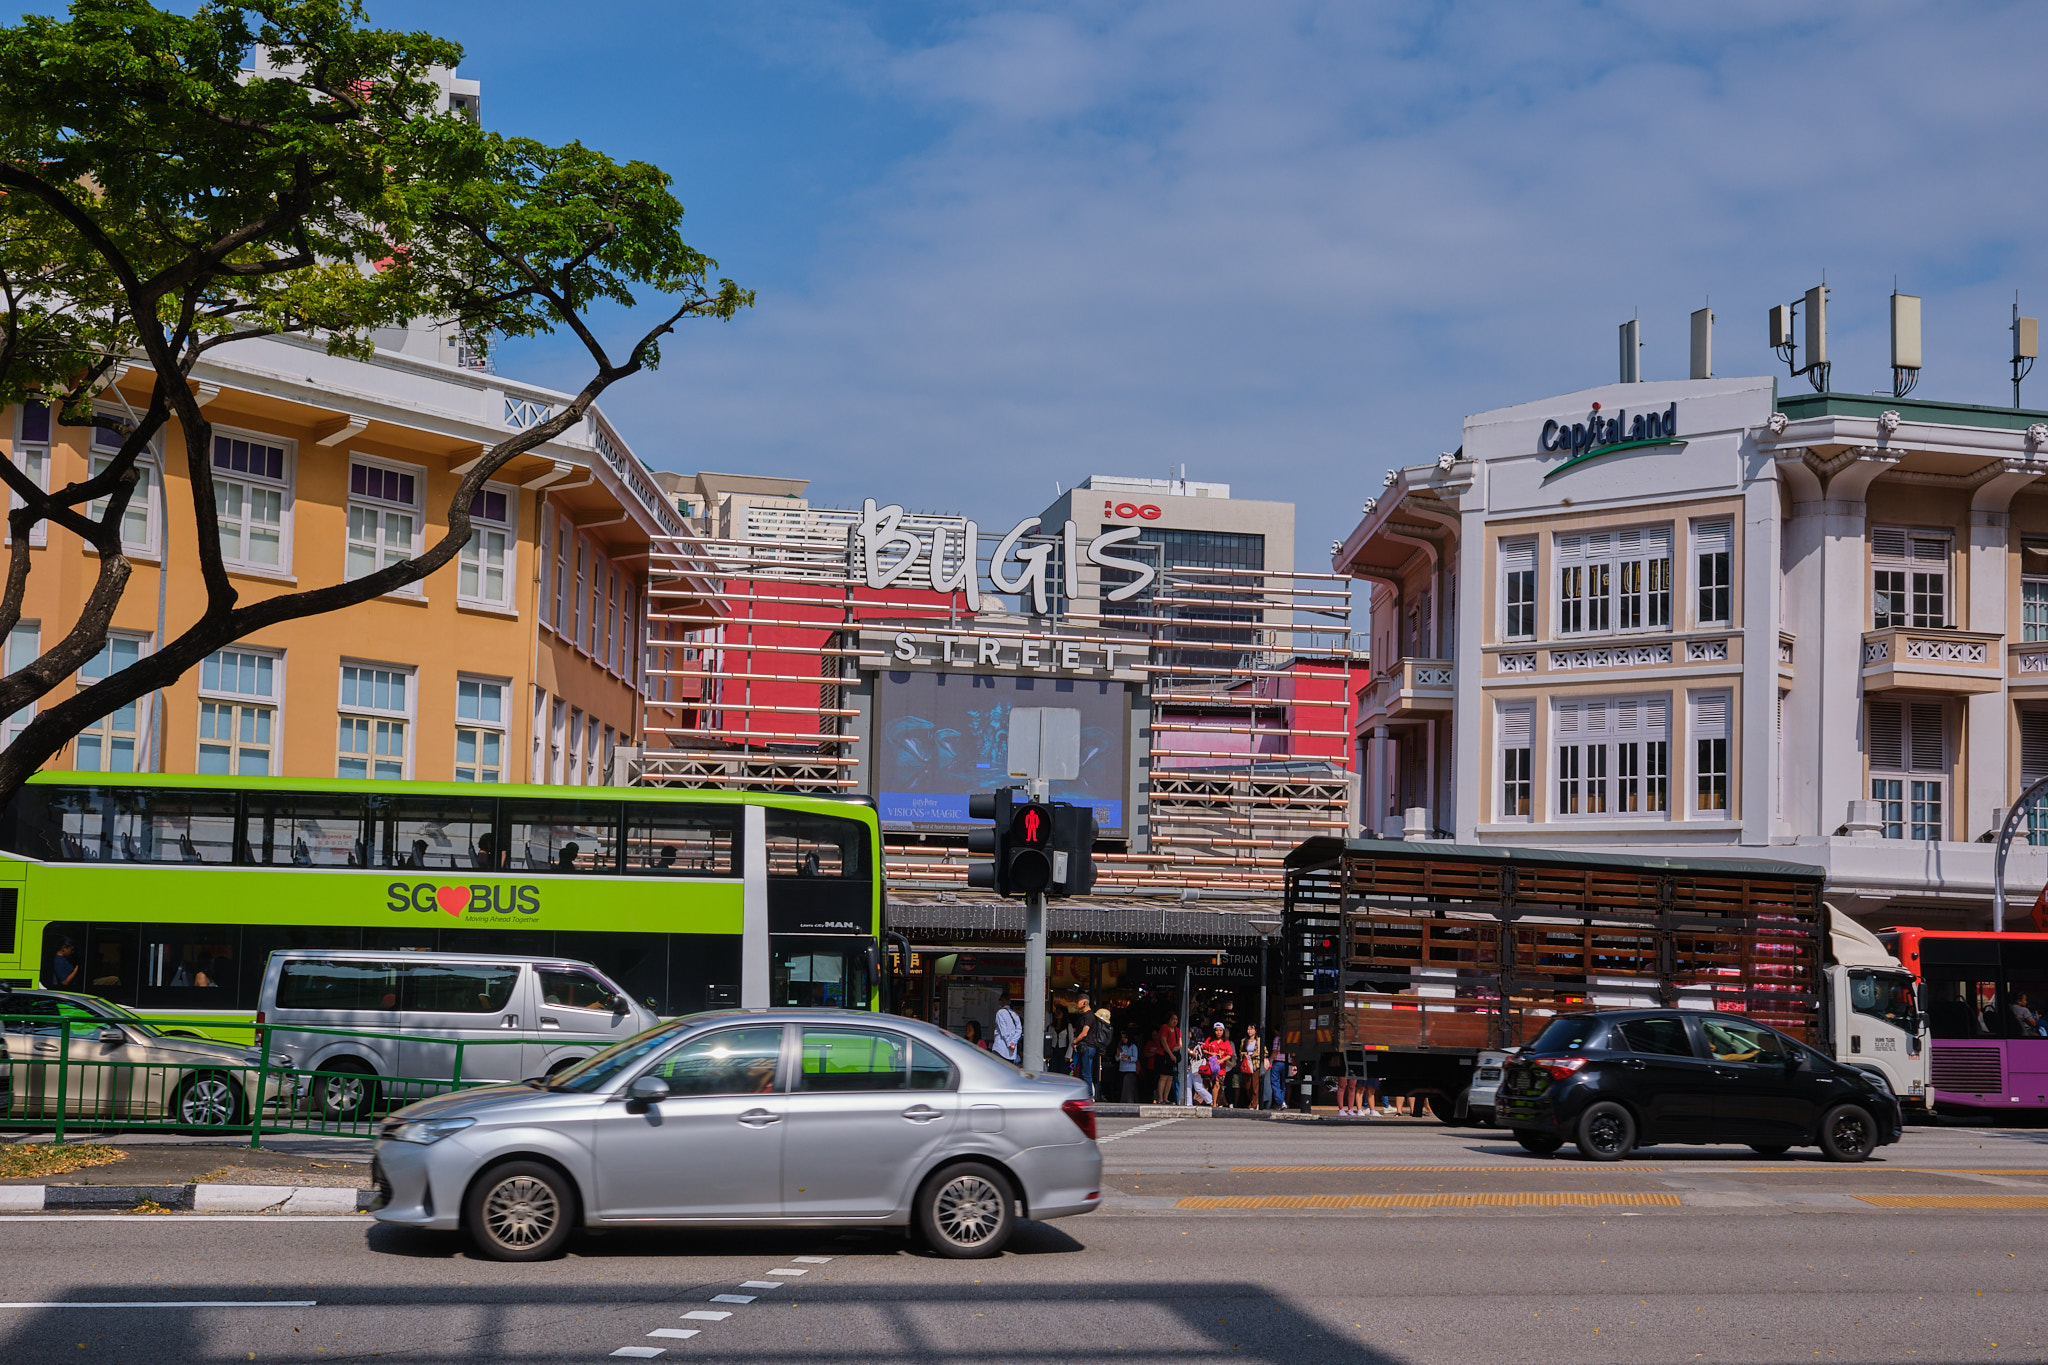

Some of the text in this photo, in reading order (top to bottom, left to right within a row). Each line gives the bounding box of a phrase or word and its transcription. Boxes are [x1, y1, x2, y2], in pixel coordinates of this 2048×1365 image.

[1542, 402, 1677, 457] CapitaLand
[1115, 502, 1162, 520] OG
[857, 497, 1155, 614] BUGIS
[894, 632, 1122, 671] STREET
[887, 807, 925, 818] VISIONS
[931, 808, 962, 819] MAGIC
[512, 916, 540, 924] Together
[1145, 966, 1168, 975] LINK
[1188, 967, 1225, 976] ALBERT
[1227, 968, 1254, 977] MALL
